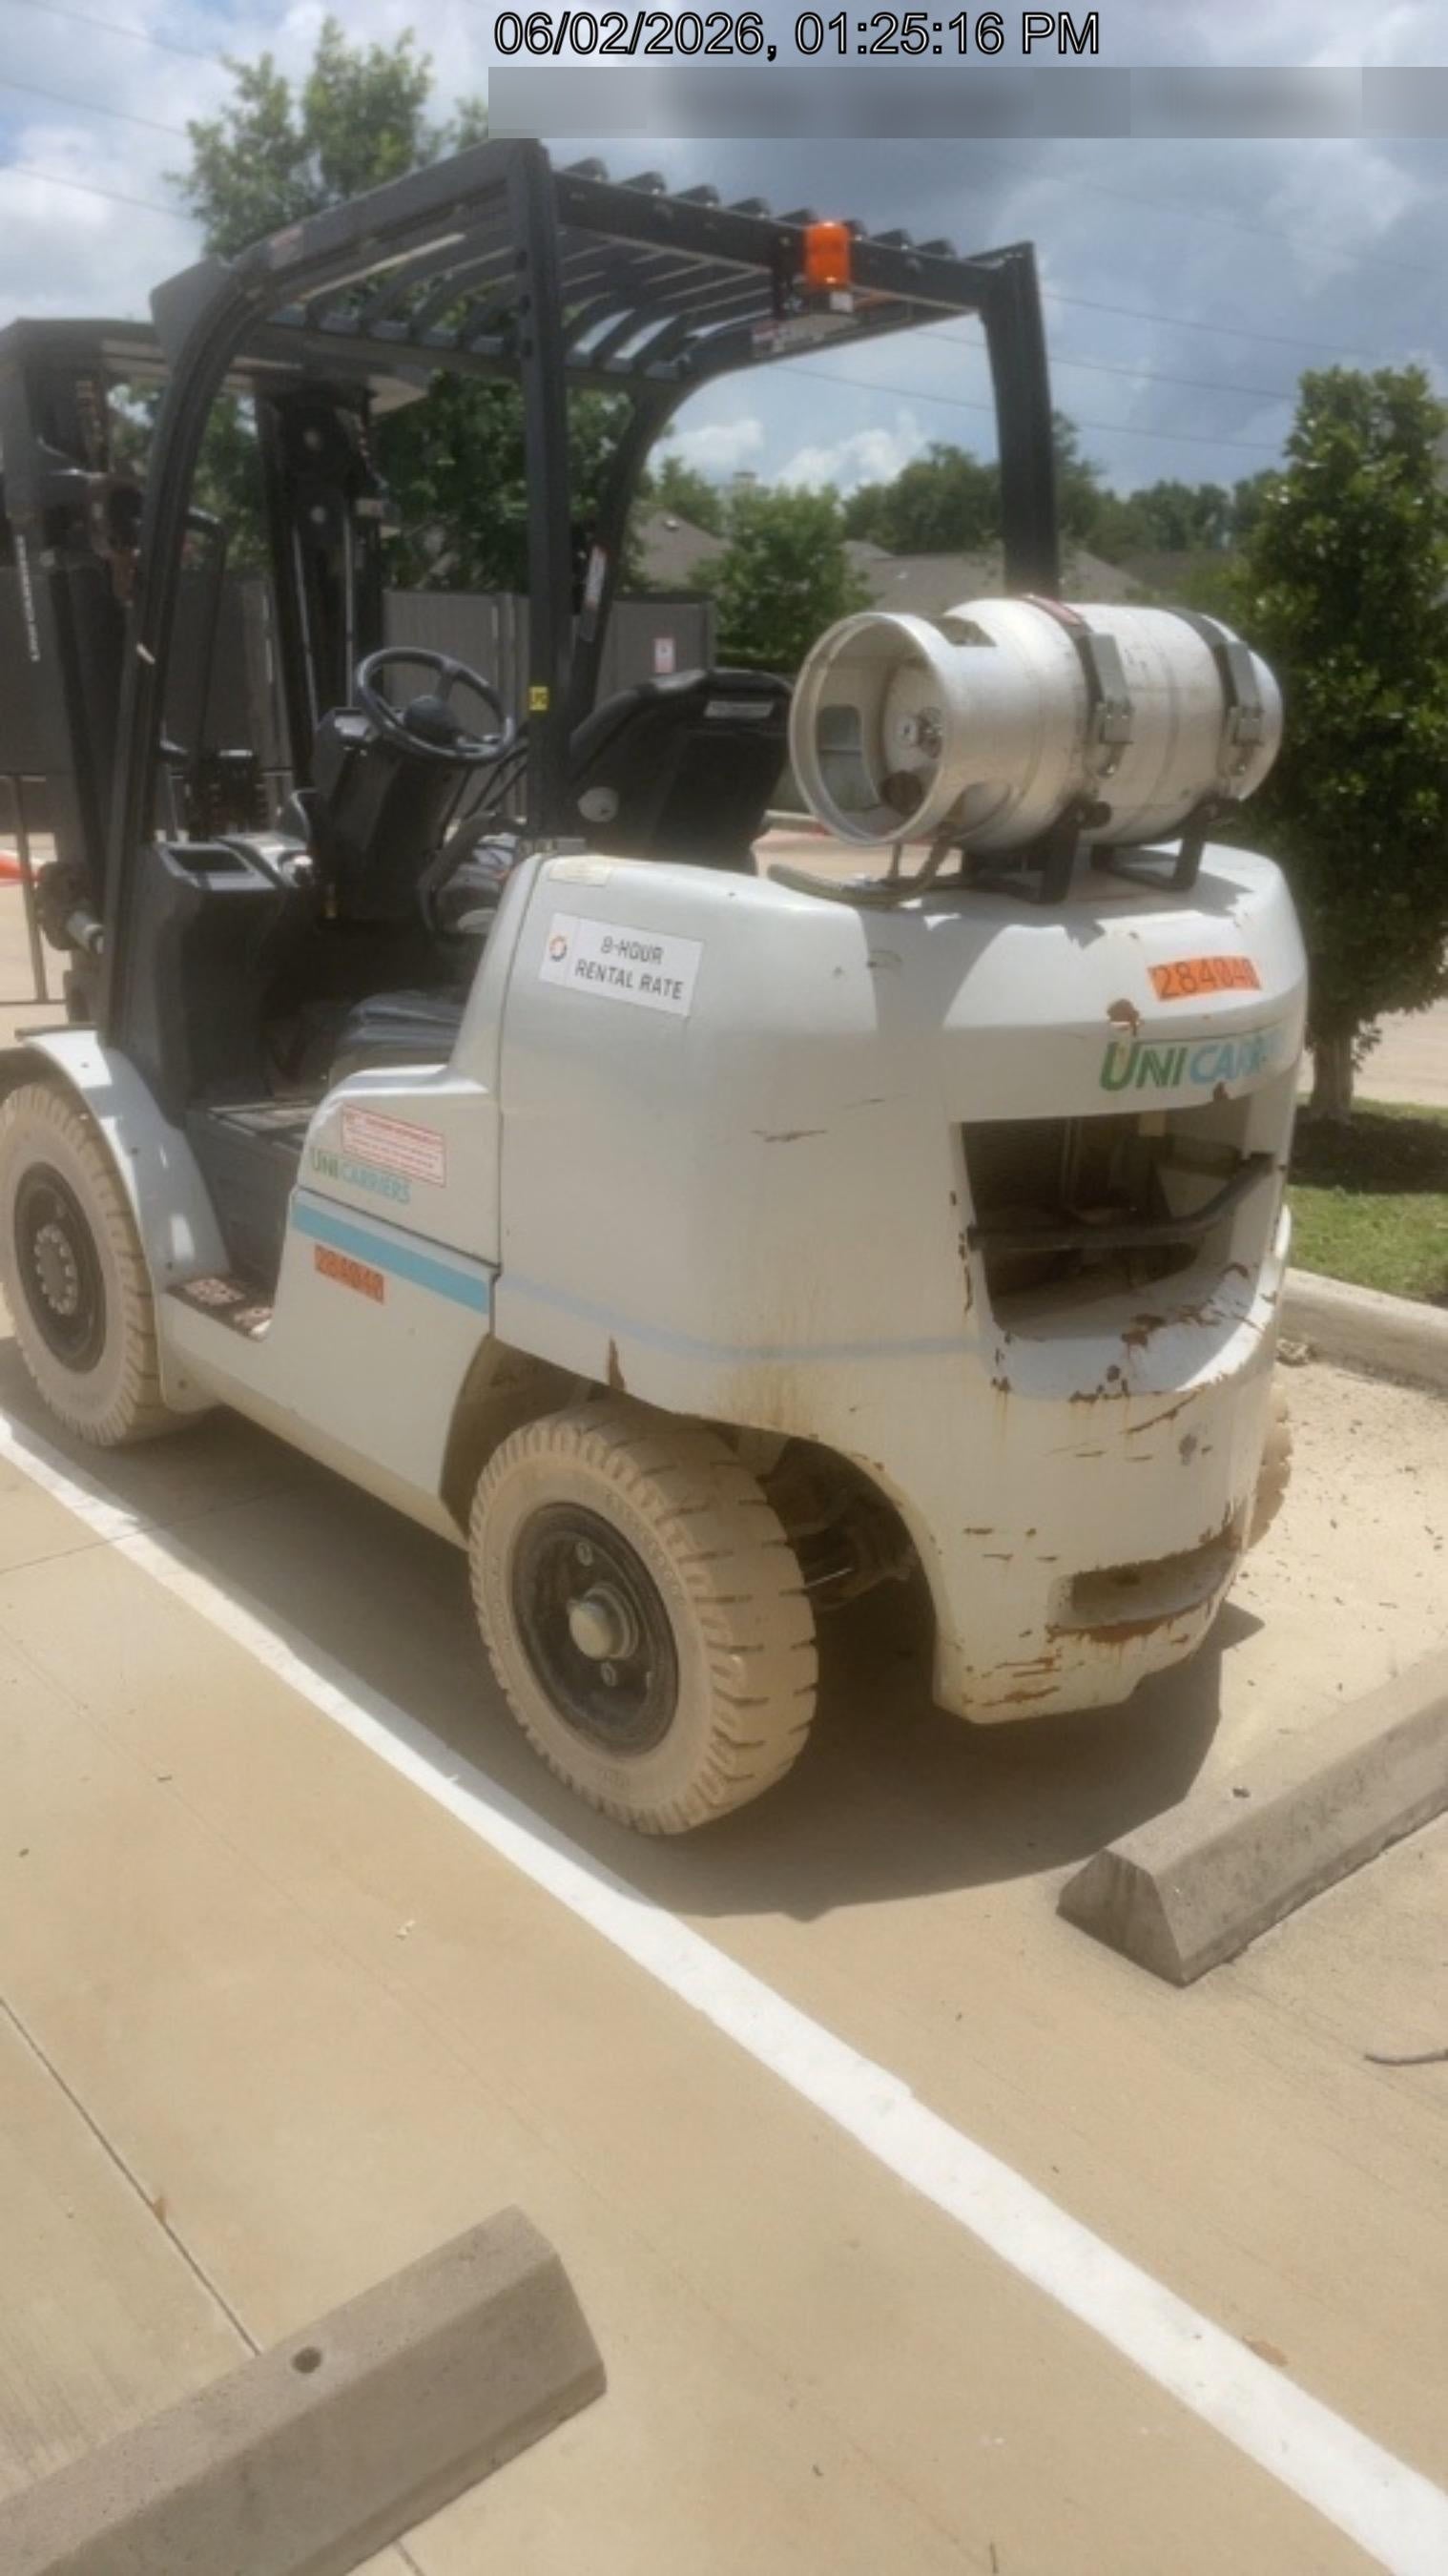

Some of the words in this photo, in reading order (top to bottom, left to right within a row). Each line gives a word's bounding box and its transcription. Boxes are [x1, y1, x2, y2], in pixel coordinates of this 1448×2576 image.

[600, 936, 665, 966] 8-HOUR
[574, 959, 633, 988] RENTAL
[638, 973, 684, 1000] RATE
